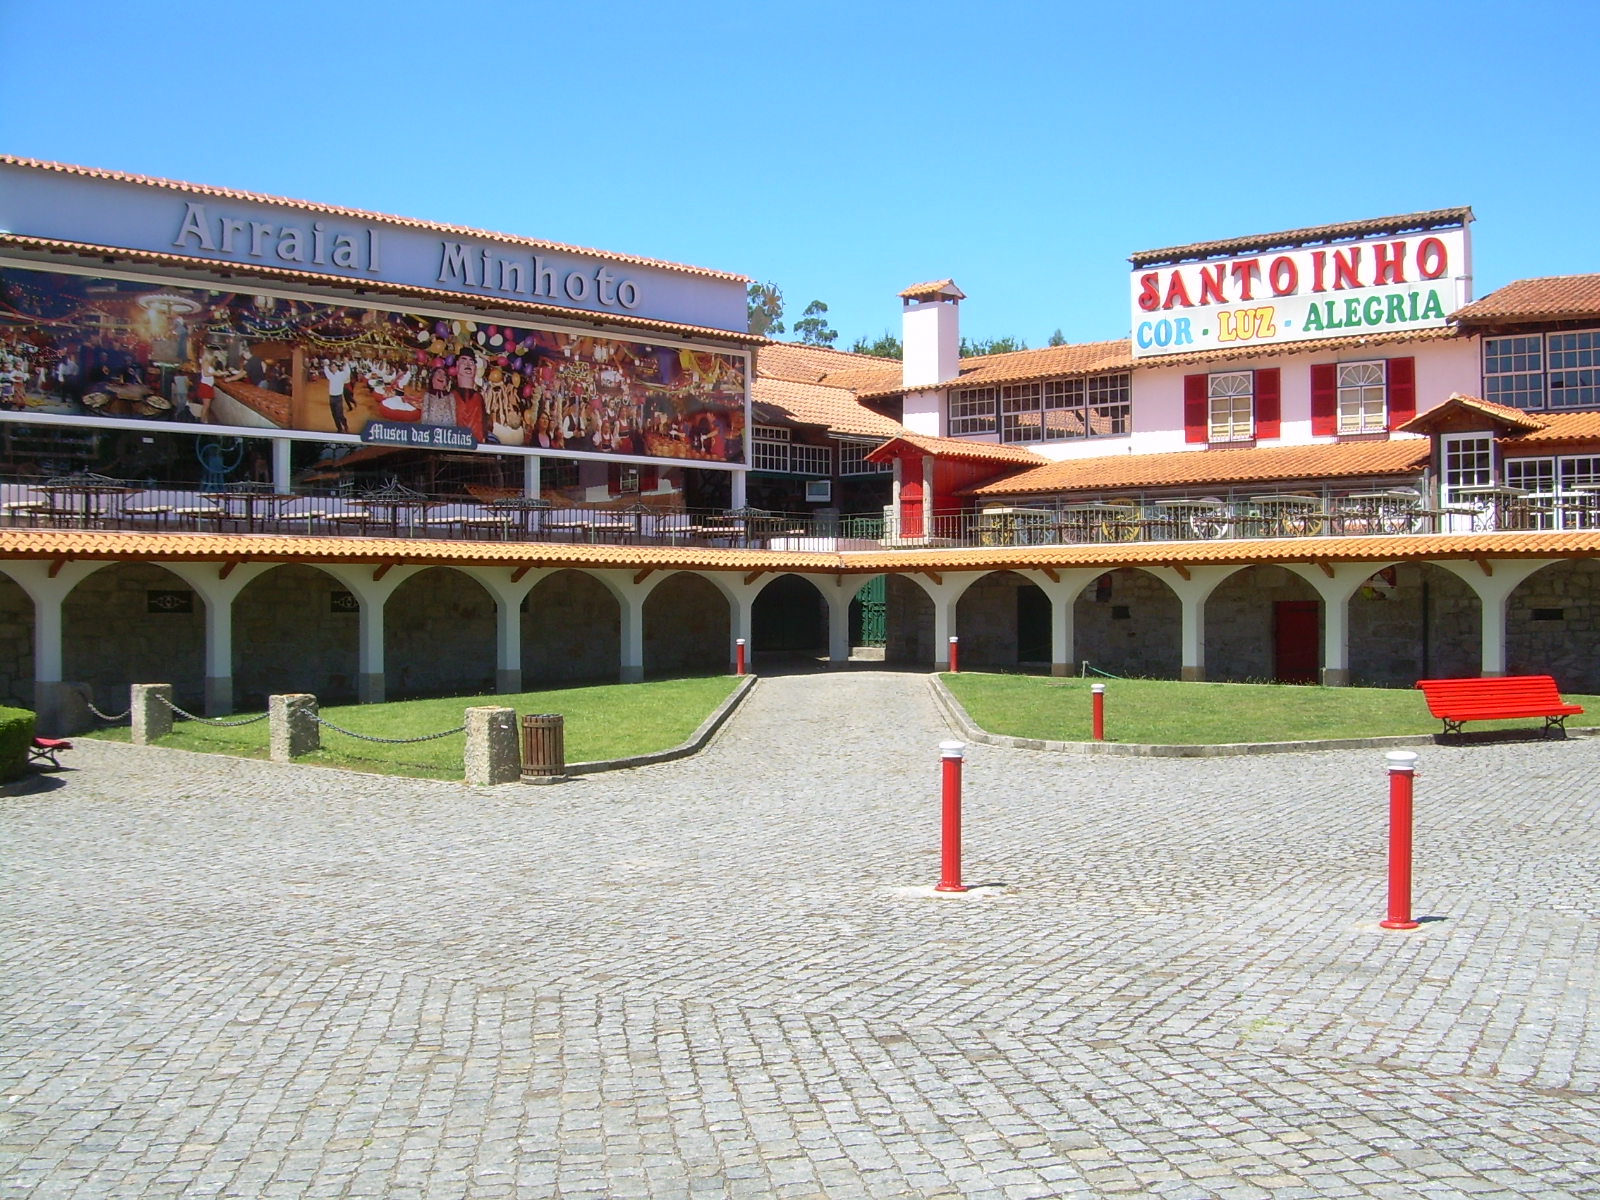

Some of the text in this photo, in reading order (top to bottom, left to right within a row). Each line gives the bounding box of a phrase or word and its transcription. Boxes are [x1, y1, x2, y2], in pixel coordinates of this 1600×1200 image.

[172, 202, 642, 309] Arraial Minhoto
[1137, 289, 1446, 349] COR LUZ ALEGRIA
[368, 423, 472, 446] Museu das Alfaias
